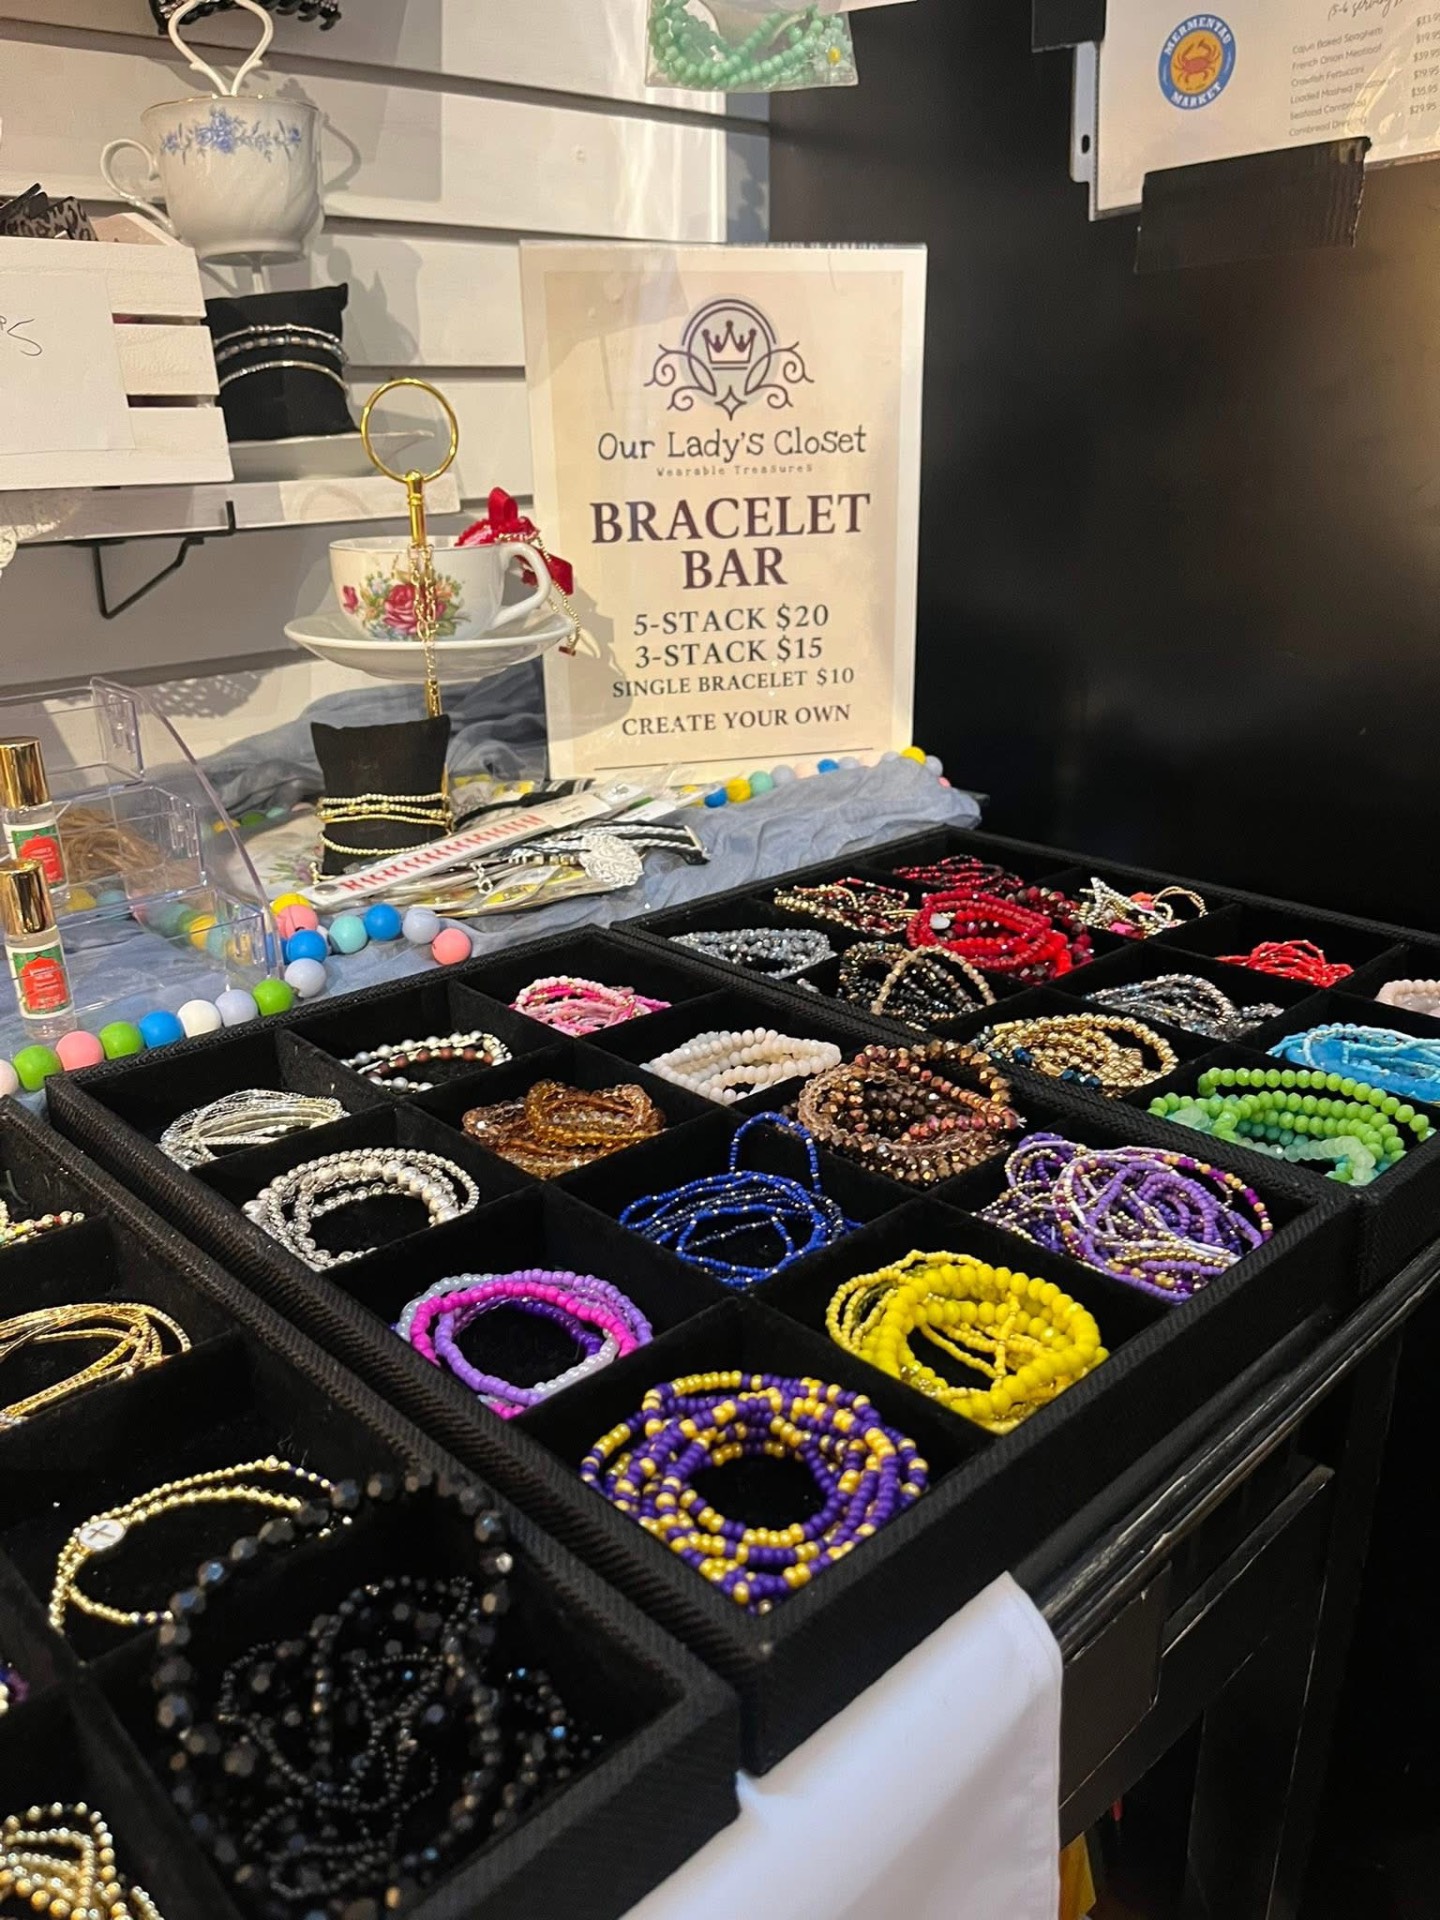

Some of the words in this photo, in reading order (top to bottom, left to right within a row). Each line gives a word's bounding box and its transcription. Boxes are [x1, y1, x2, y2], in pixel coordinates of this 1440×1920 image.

[1170, 81, 1221, 107] MARKET
[598, 432, 656, 461] Our
[668, 427, 764, 463] Lady's
[774, 424, 867, 456] Closet
[657, 468, 726, 478] Wearable
[734, 463, 813, 475] Treasures
[590, 493, 871, 544] BRACELET
[682, 546, 788, 590] BAR
[633, 606, 767, 637] 5-STACK
[776, 602, 830, 632] $20
[635, 638, 767, 669] 3-STACK
[777, 635, 823, 662] $15
[612, 678, 691, 699] SINGLE
[699, 670, 808, 693] BRACELET
[816, 667, 855, 687] $10
[622, 713, 717, 737] CREATE
[723, 709, 788, 730] YOUR
[795, 704, 852, 724] OWN
